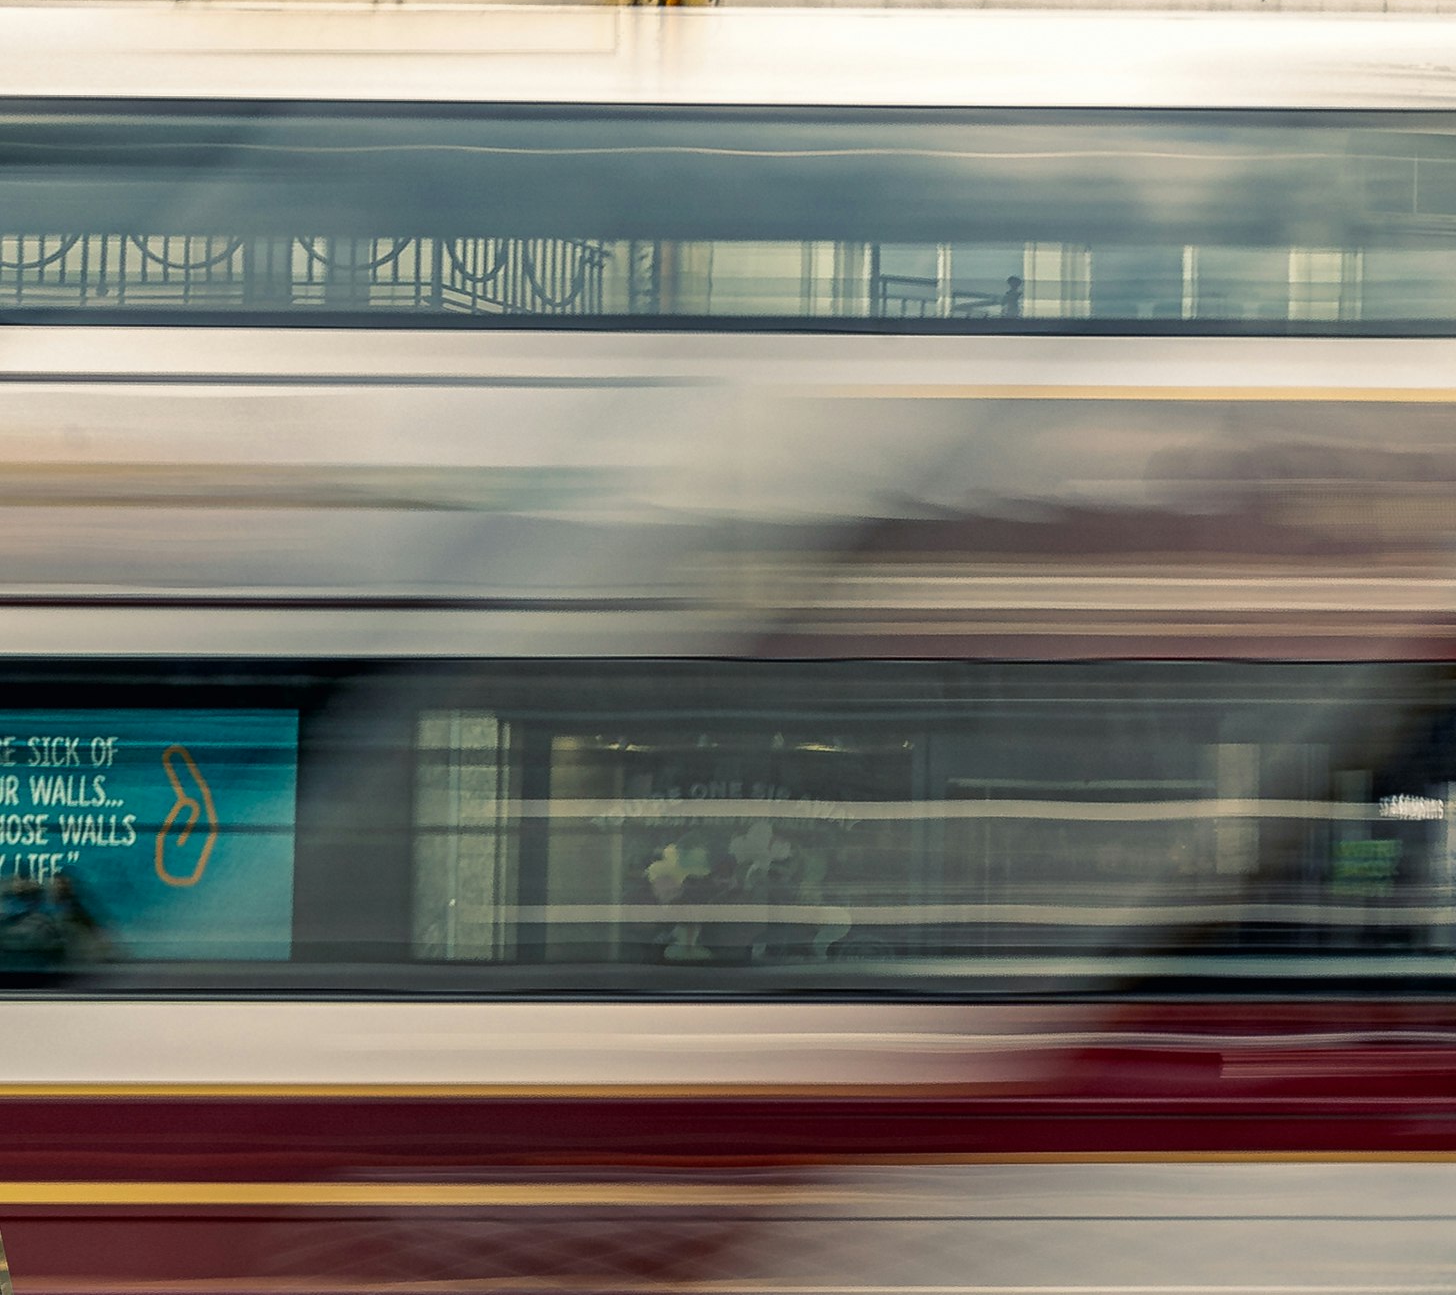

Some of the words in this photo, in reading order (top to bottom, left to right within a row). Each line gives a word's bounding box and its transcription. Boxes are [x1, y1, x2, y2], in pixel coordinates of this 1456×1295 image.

[28, 737, 80, 767] SICK
[91, 737, 119, 767] OF
[59, 814, 137, 846] WALLS
